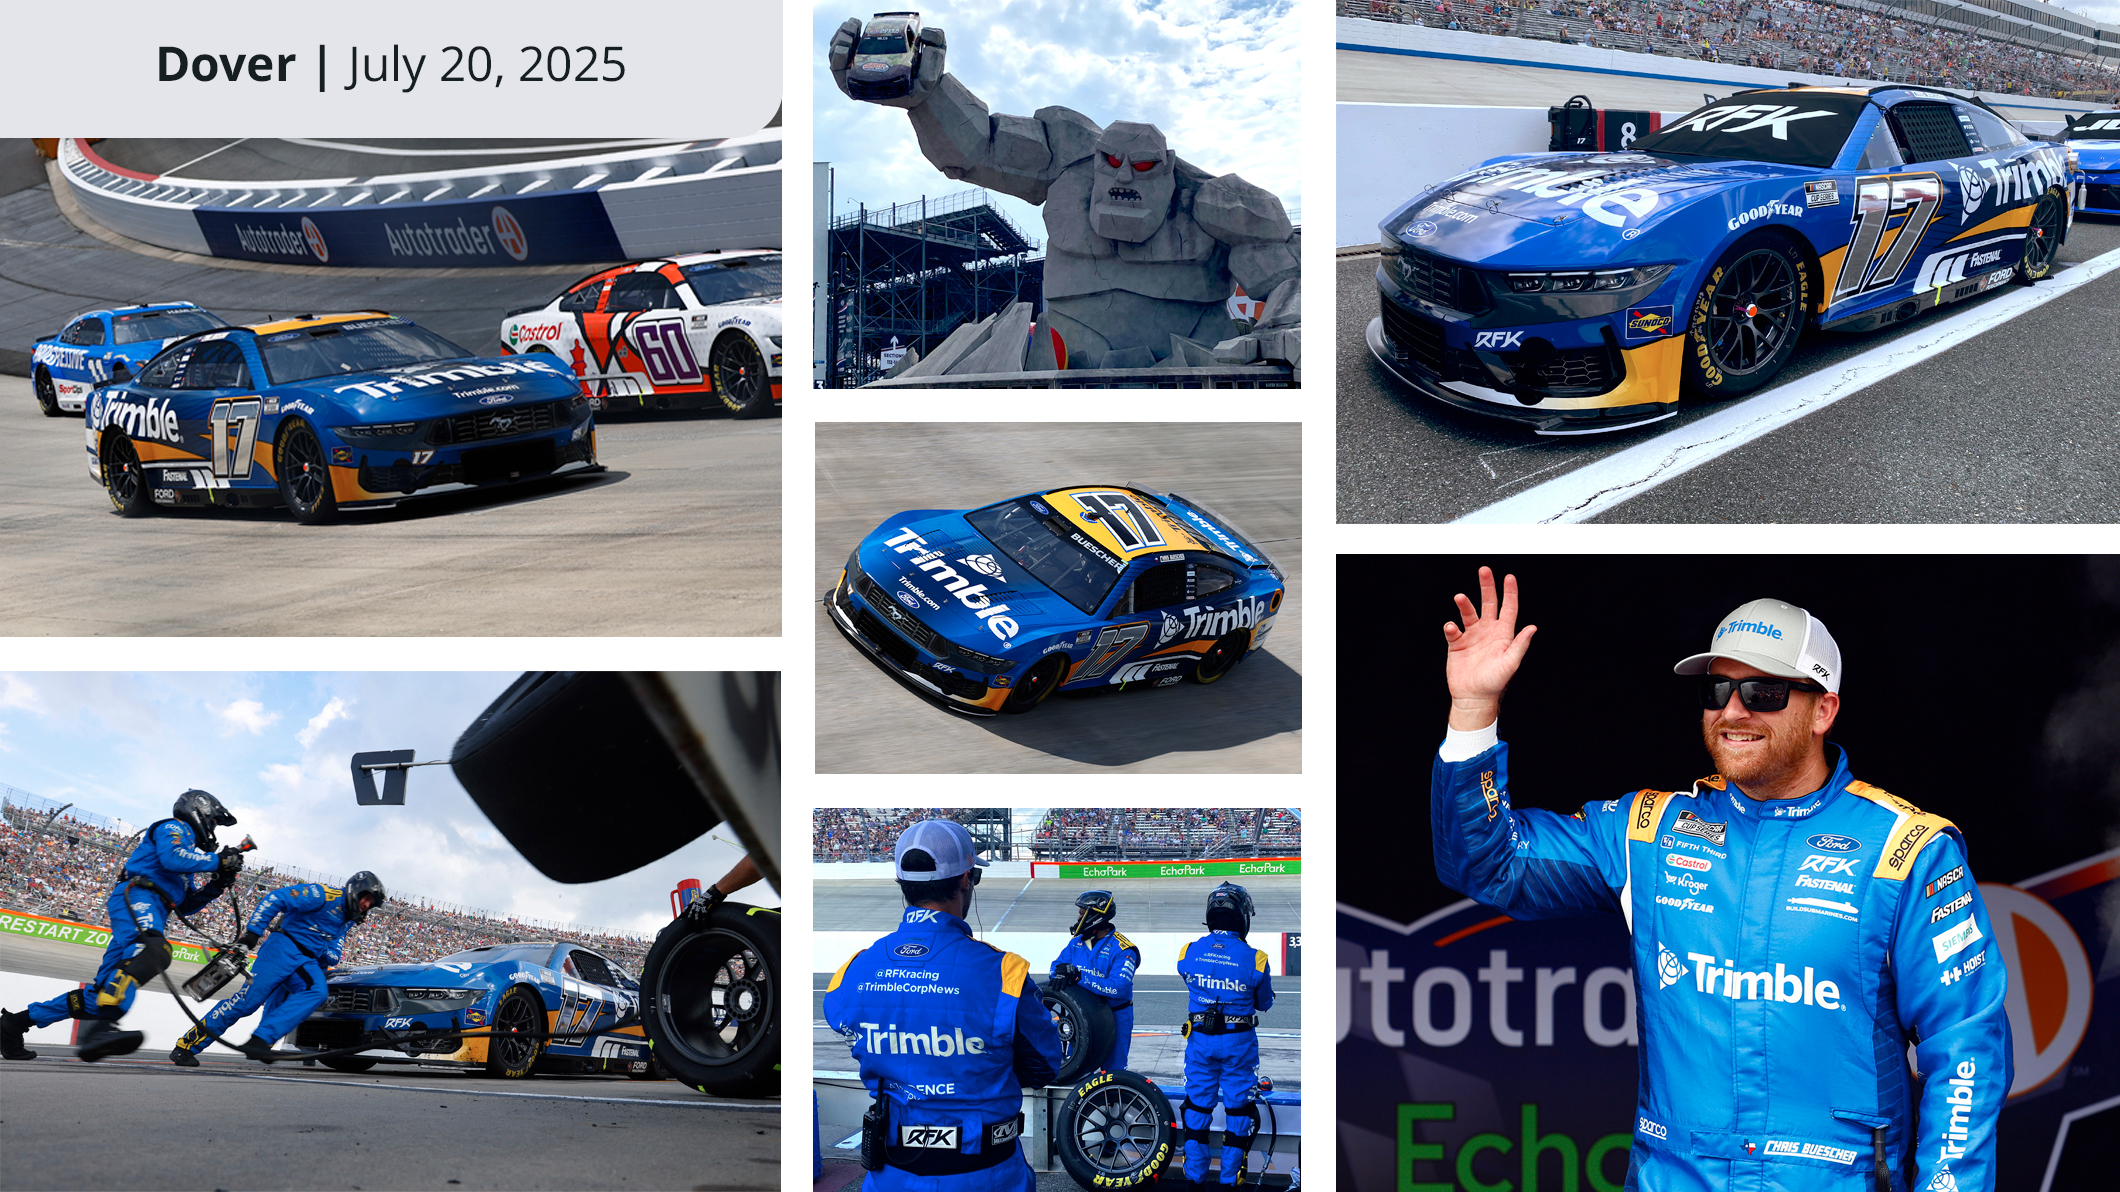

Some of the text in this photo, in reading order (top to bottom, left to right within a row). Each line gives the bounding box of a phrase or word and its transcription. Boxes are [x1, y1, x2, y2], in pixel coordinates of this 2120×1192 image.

[1659, 104, 1839, 140] RFK
[1621, 122, 1637, 150] 8
[1815, 182, 1833, 191] NASCAR
[1811, 192, 1835, 202] CUP SERIES
[234, 222, 309, 256] Autotrader
[384, 216, 497, 257] Autotrader
[1829, 173, 1942, 307] 17
[1970, 249, 2001, 268] FASTENAL
[1988, 267, 2013, 284] FORD
[1796, 261, 1809, 312] EAGLE
[519, 321, 564, 343] Castrol
[1629, 316, 1671, 329] SUNOCO
[1474, 331, 1524, 347] RFK
[633, 318, 703, 385] 60
[333, 360, 558, 399] Trimble
[452, 384, 520, 399] Trimble.com
[590, 398, 601, 406] RD
[101, 390, 180, 443] Trimble
[208, 395, 263, 480] 17
[412, 450, 435, 465] 17
[163, 469, 188, 482] FASTENAL
[154, 489, 175, 499] FORD
[1186, 509, 1240, 552] Trimble
[883, 526, 1020, 641] Trimble
[898, 576, 940, 611] Trimble.com
[898, 592, 918, 608] Ford
[1183, 595, 1265, 640] Trimble
[1728, 619, 1783, 641] Trimble
[1066, 621, 1150, 685] 17
[933, 661, 956, 674] RFK
[1152, 662, 1180, 673] FASTENAL
[1812, 663, 1830, 681] RFK
[1159, 675, 1183, 685] FORD
[1480, 770, 1500, 822] sparco
[1695, 826, 1721, 841] SERIES
[1816, 835, 1851, 852] Ford
[1676, 840, 1700, 852] FIFTH
[1701, 845, 1727, 860] THIRD
[1889, 824, 1930, 871] sparco
[1083, 866, 1127, 877] EchoPark
[1160, 865, 1205, 876] EchoPark
[1239, 862, 1286, 874] EchoPark
[1675, 856, 1709, 870] Castrol
[1797, 854, 1861, 877] RFK
[1677, 873, 1709, 896] Kroger
[1794, 874, 1855, 895] FASTENAL
[1936, 865, 1964, 892] NASCA
[1655, 895, 1715, 914] GOODYEAR
[1786, 906, 1858, 923] BUILDSUBMARINES.COM
[1930, 890, 1974, 925] FASTENAL
[906, 909, 941, 923] RFK
[0, 914, 82, 941] RESTART
[171, 946, 200, 963] oPark
[900, 945, 923, 955] Ford
[1962, 950, 1986, 972] HOIST
[875, 969, 940, 981] @RFKracing
[1194, 973, 1248, 992] Trimble
[1687, 951, 1841, 1010] Trimble
[499, 986, 518, 1006] EAGLE
[857, 982, 960, 996] @TrimbleCorpNews
[1336, 949, 1638, 1047] totra
[550, 976, 605, 1048] 17
[385, 1017, 413, 1028] RFK
[860, 1022, 985, 1058] Trimble
[621, 1046, 639, 1058] FASTENAL
[632, 1061, 647, 1070] FORD
[907, 1083, 955, 1097] ENCE
[1077, 1073, 1114, 1098] EAGLE
[1936, 1060, 1976, 1164] Trimble
[906, 1128, 955, 1146] RFK
[1639, 1117, 1667, 1140] sparco
[1765, 1140, 1858, 1164] CHRIS BUESCHER
